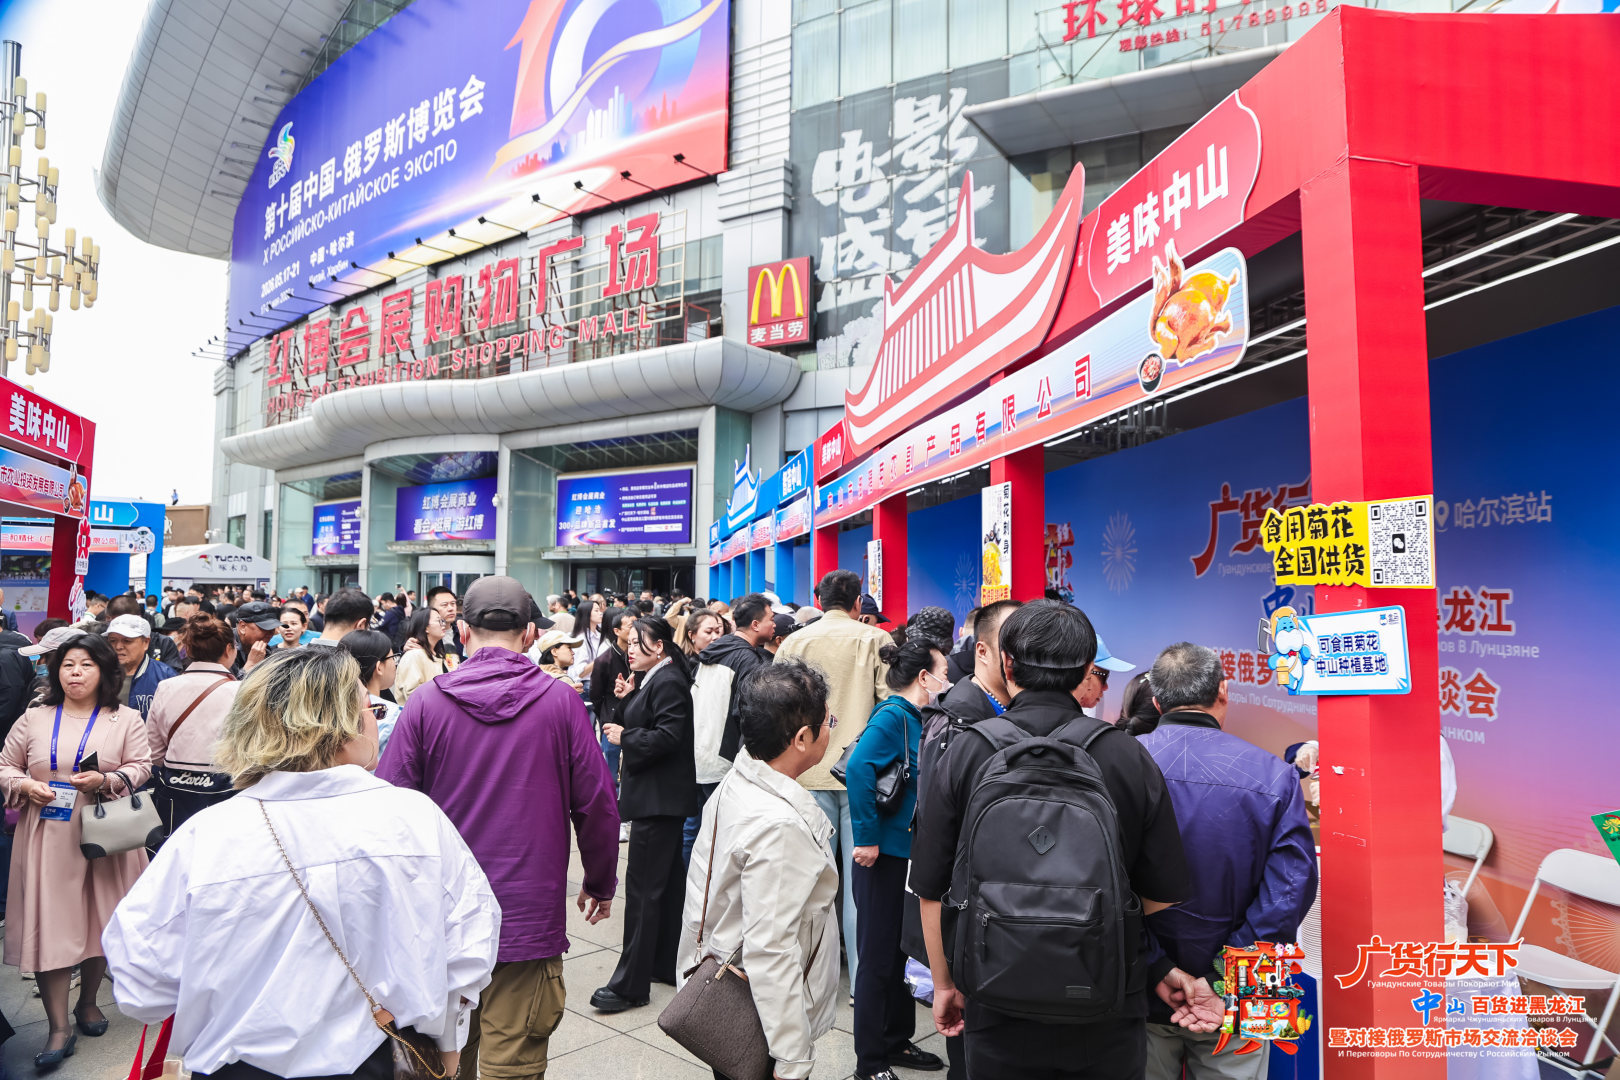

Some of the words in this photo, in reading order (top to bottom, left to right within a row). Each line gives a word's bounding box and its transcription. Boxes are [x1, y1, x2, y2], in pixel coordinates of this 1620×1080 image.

[1063, 0, 1253, 42] 环球
[264, 74, 486, 240] 第十届中国-俄罗斯博览会
[270, 167, 400, 260] РОССИЙСКО-КИТАЙСКОЕ
[404, 139, 457, 181] ЭКСПО
[1107, 143, 1229, 275] 美味中山
[267, 211, 662, 388] 红博会展购物广场
[451, 325, 564, 372] SHOPPING
[578, 307, 653, 344] MALL
[750, 320, 804, 344] 麦当劳
[9, 391, 70, 454] 美味中山
[1264, 505, 1355, 544] 食用菊花
[1455, 491, 1553, 528] 哈尔滨站
[214, 555, 253, 563] TUCANO
[1274, 543, 1366, 577] 全国供货
[1437, 590, 1513, 633] 龙江
[1320, 634, 1379, 654] 可食用菊花
[1469, 640, 1540, 659] Лунцзяне
[1317, 655, 1388, 675] 中山种植基地
